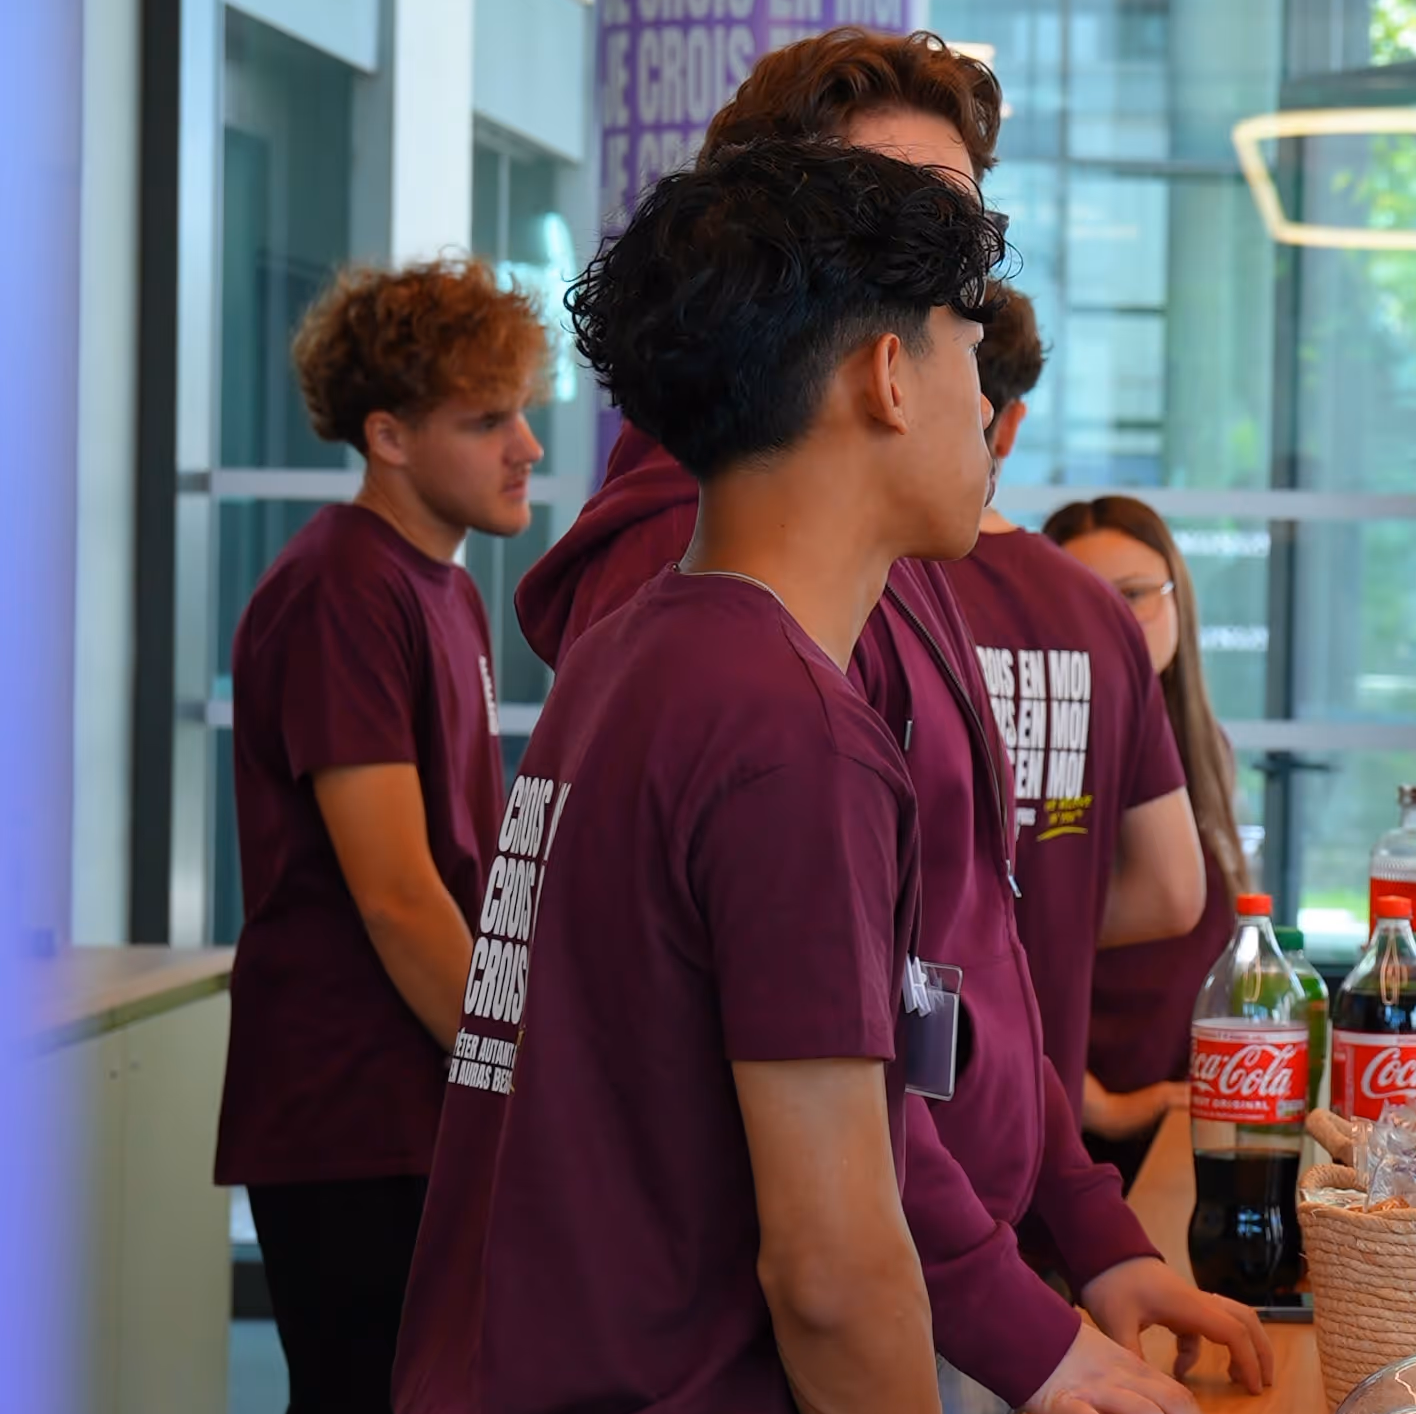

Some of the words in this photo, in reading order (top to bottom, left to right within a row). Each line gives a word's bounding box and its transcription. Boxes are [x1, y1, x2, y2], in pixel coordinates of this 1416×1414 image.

[976, 646, 1015, 696] OIS
[1018, 649, 1046, 700] EN
[1048, 650, 1091, 702] MOI
[1018, 698, 1046, 750] EN
[1050, 700, 1090, 751] MOI
[1016, 750, 1044, 799] EN
[1046, 750, 1085, 800] MOI
[499, 775, 554, 858] CROIS
[480, 855, 537, 942] CROIS
[464, 936, 528, 1025] CROIS
[456, 1060, 493, 1091] AURAS
[477, 1036, 516, 1068] AUTANT
